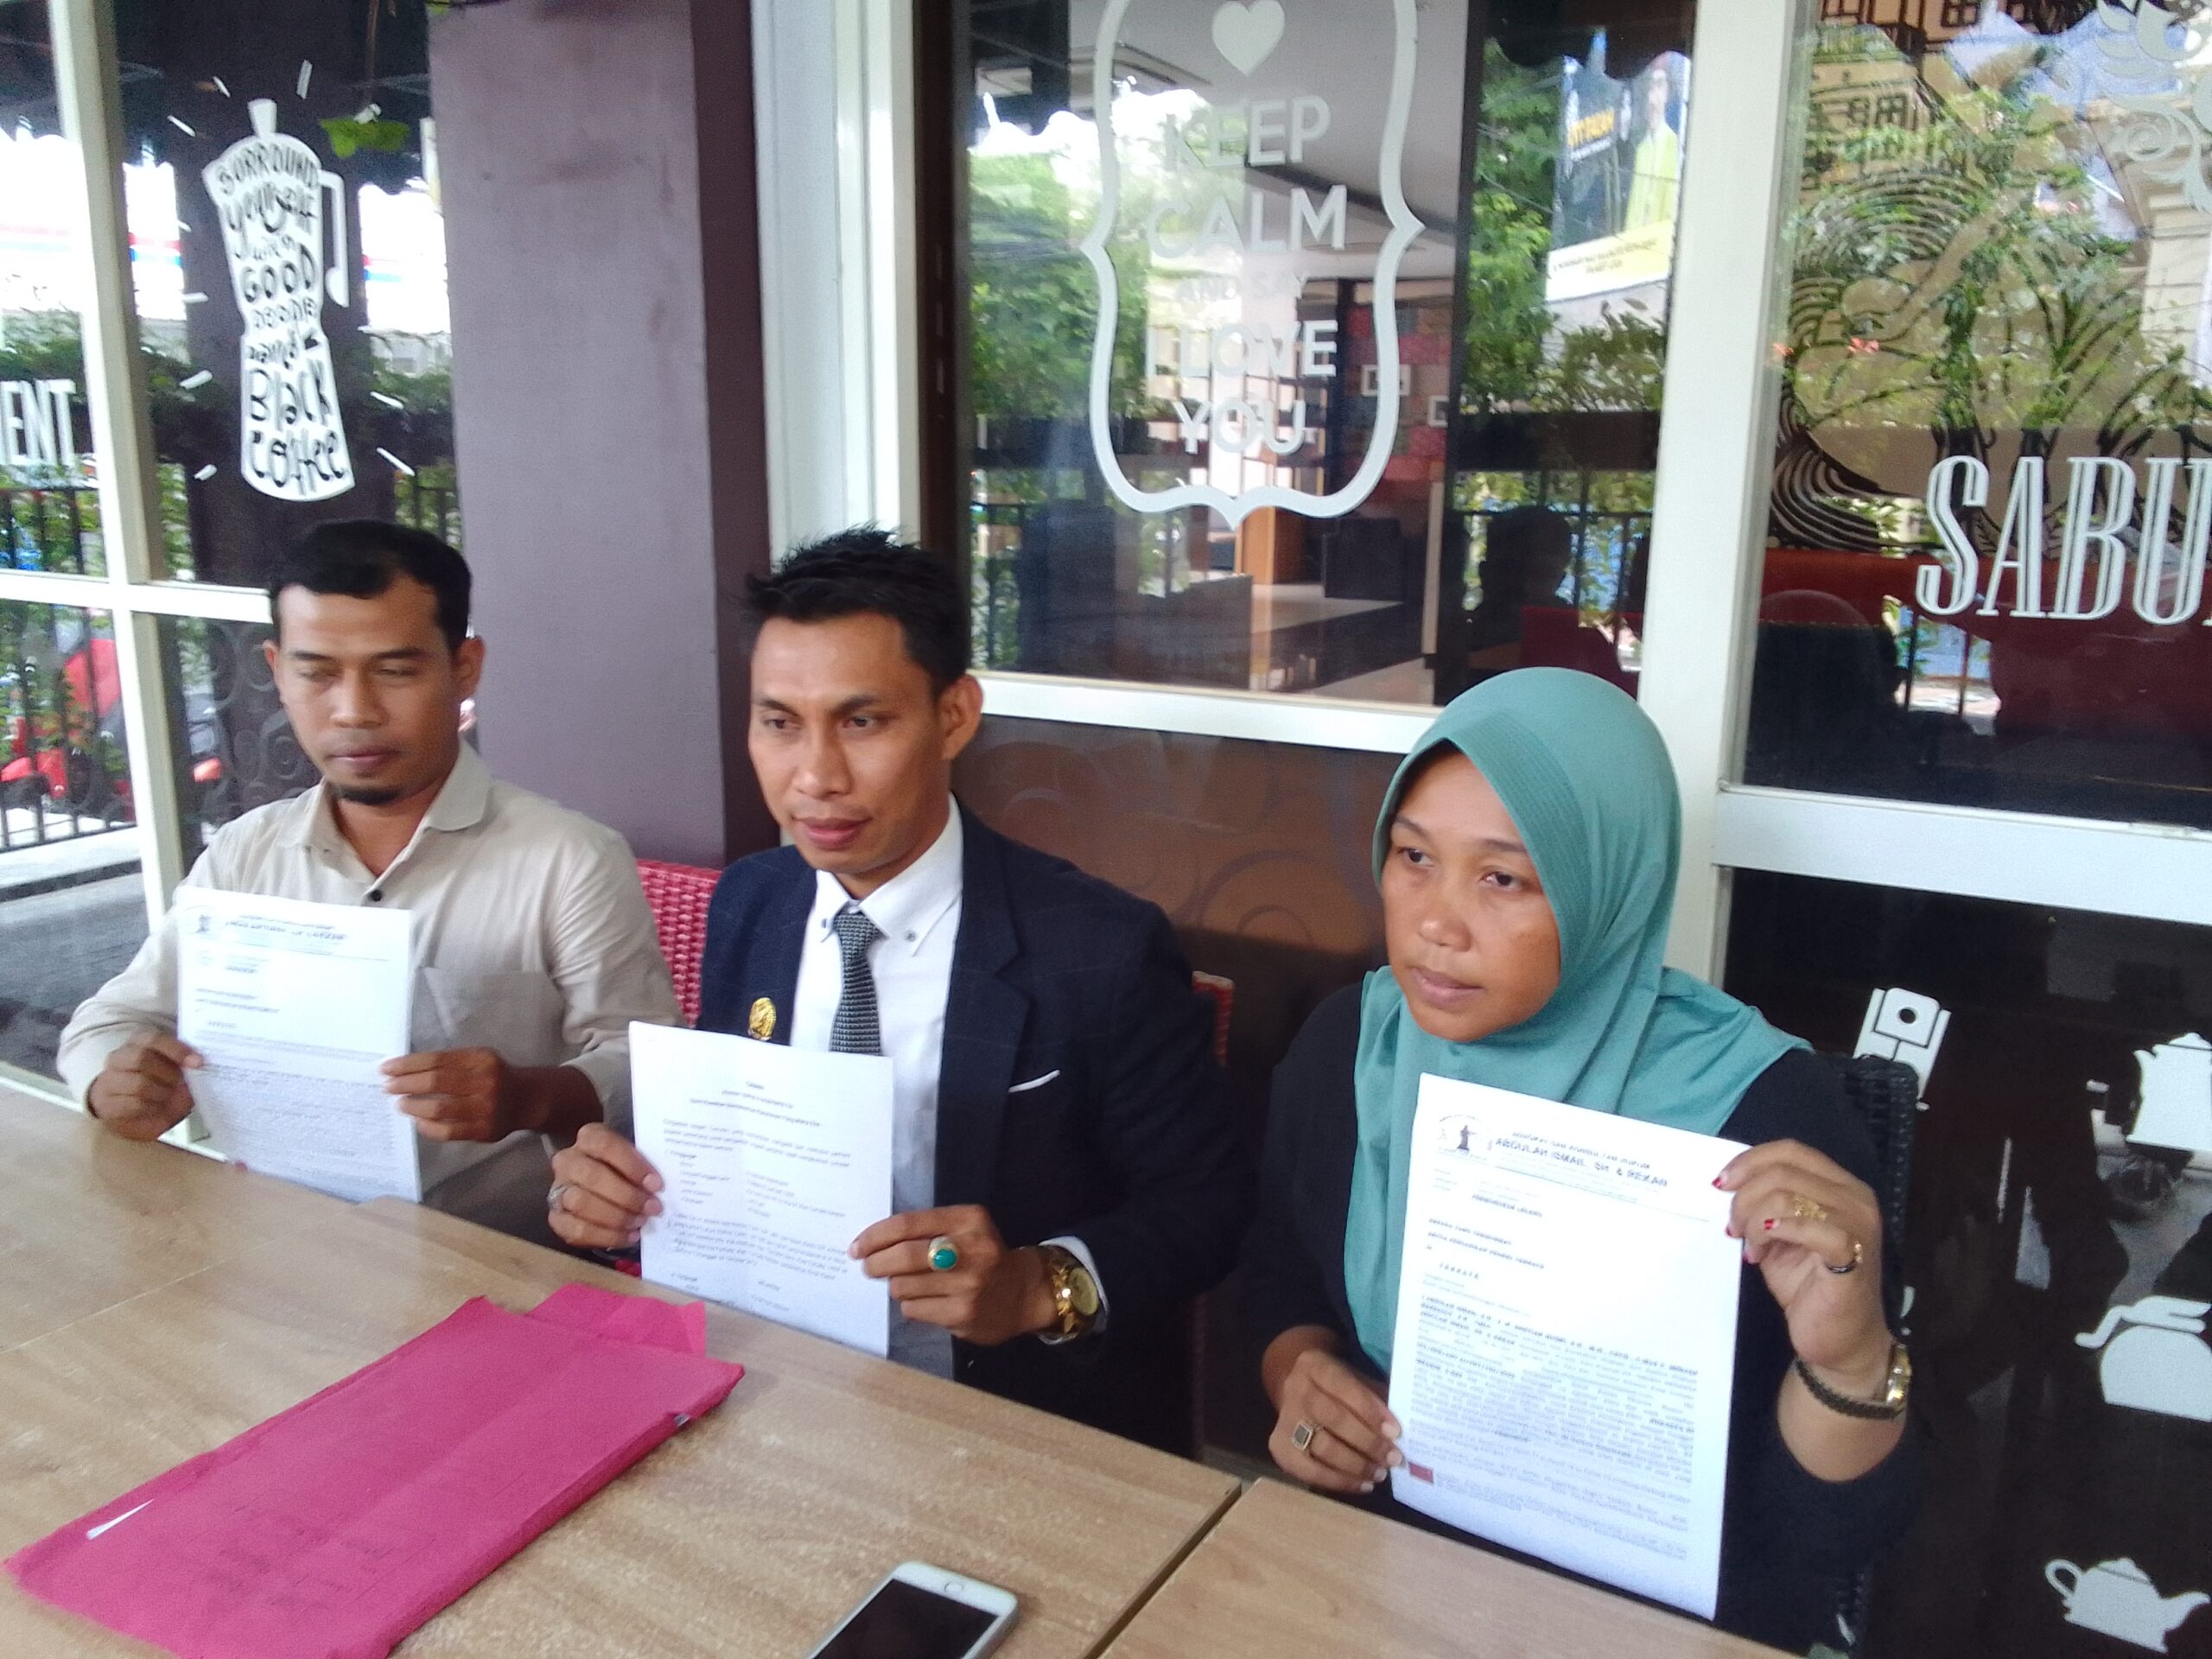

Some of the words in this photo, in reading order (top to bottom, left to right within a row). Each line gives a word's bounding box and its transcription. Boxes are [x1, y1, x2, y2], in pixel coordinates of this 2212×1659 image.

[1164, 95, 1331, 172] KEEP
[216, 144, 319, 196] SURROUND
[1147, 185, 1347, 259] CALM
[241, 242, 317, 302] GOOD
[1179, 320, 1338, 378] LOVE
[0, 378, 77, 467] ENT
[1172, 397, 1306, 455] YOU
[1915, 454, 2212, 626] SABU
